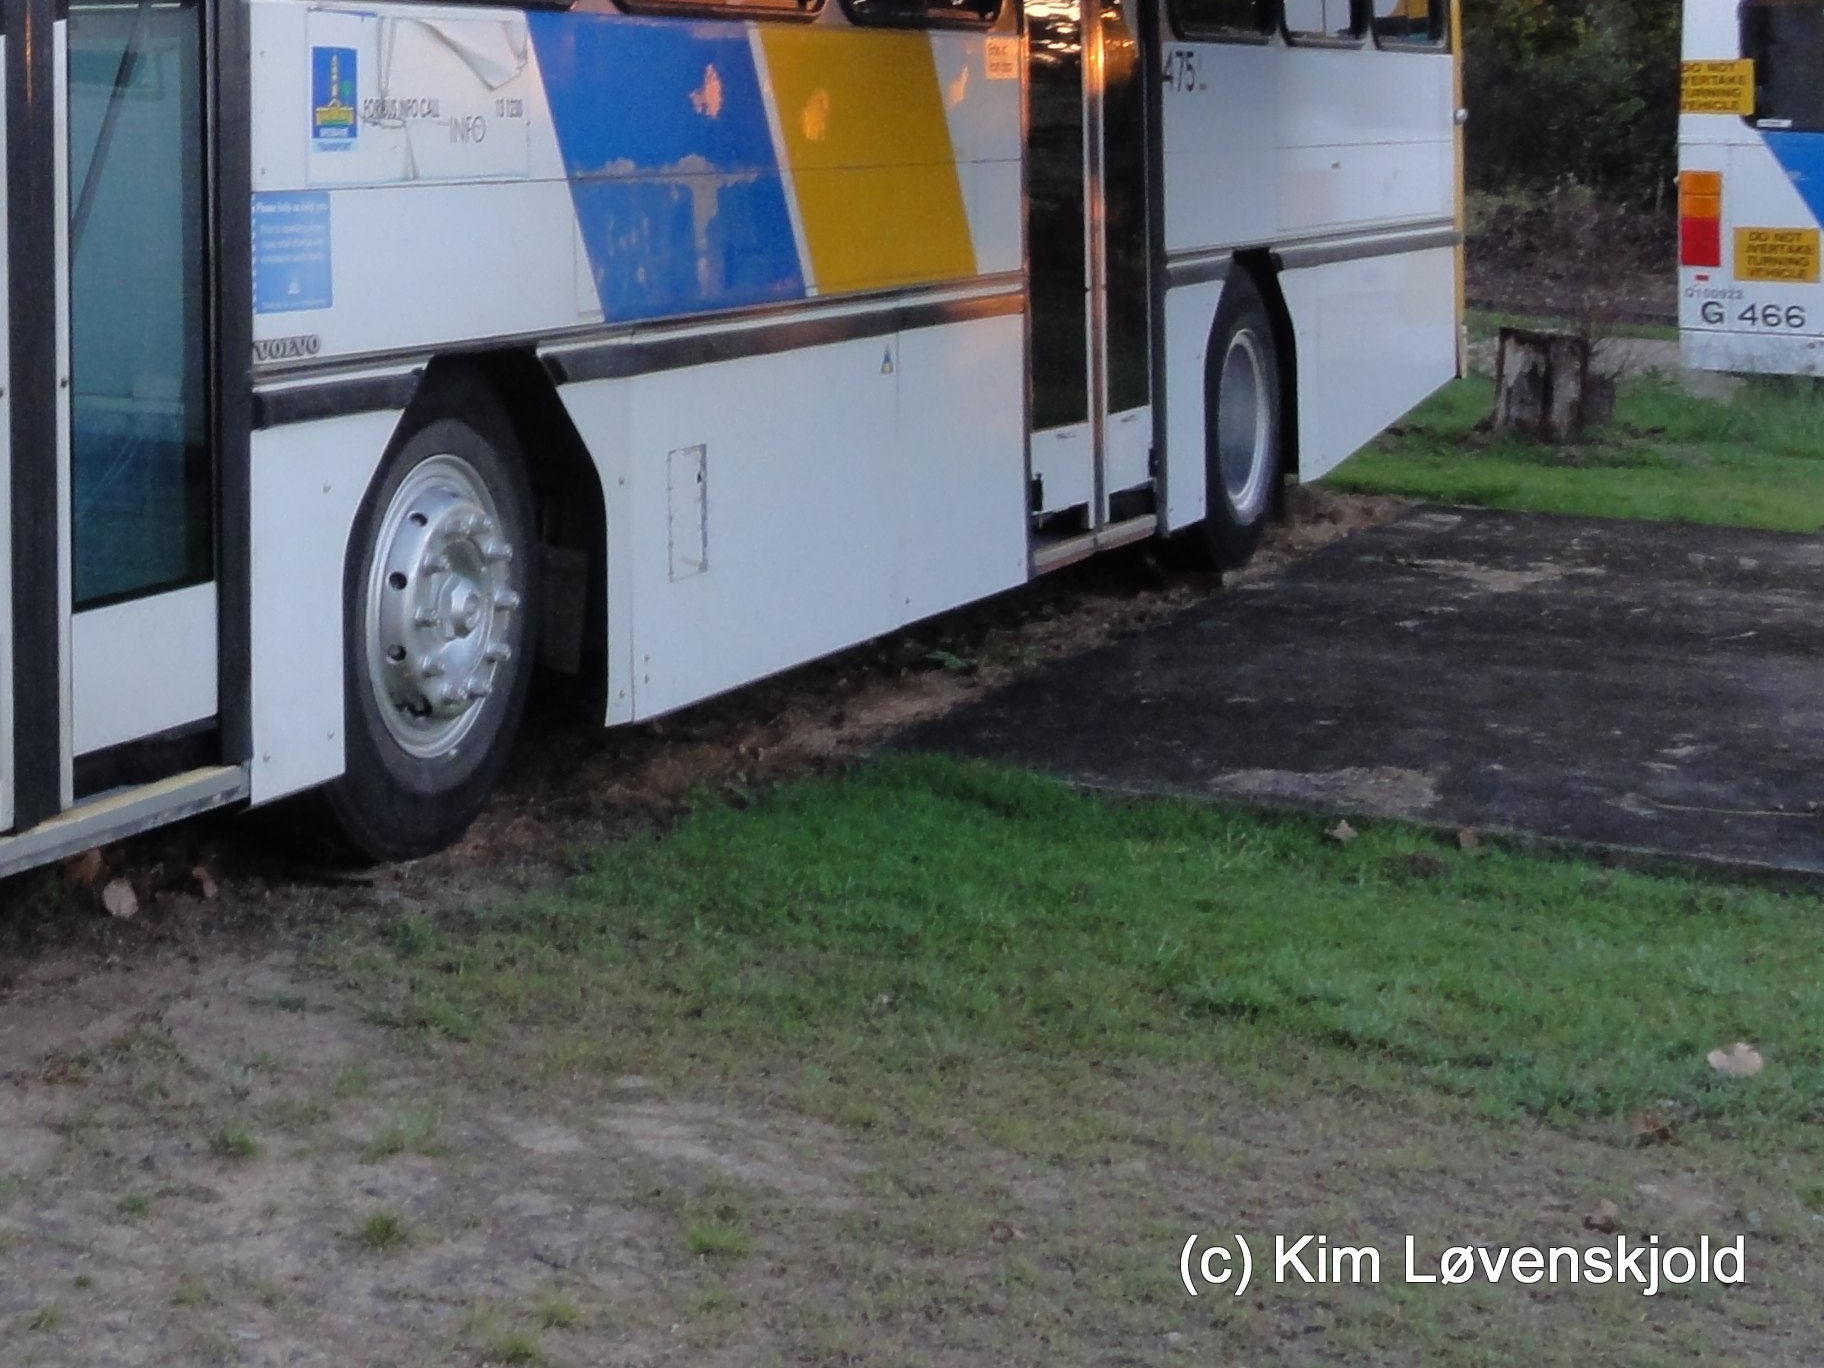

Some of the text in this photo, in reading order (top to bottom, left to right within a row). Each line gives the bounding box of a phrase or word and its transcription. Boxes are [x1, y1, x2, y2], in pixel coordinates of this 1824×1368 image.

[1160, 50, 1195, 93] 475
[1700, 300, 1806, 329] G 466
[253, 333, 321, 361] VOLVO
